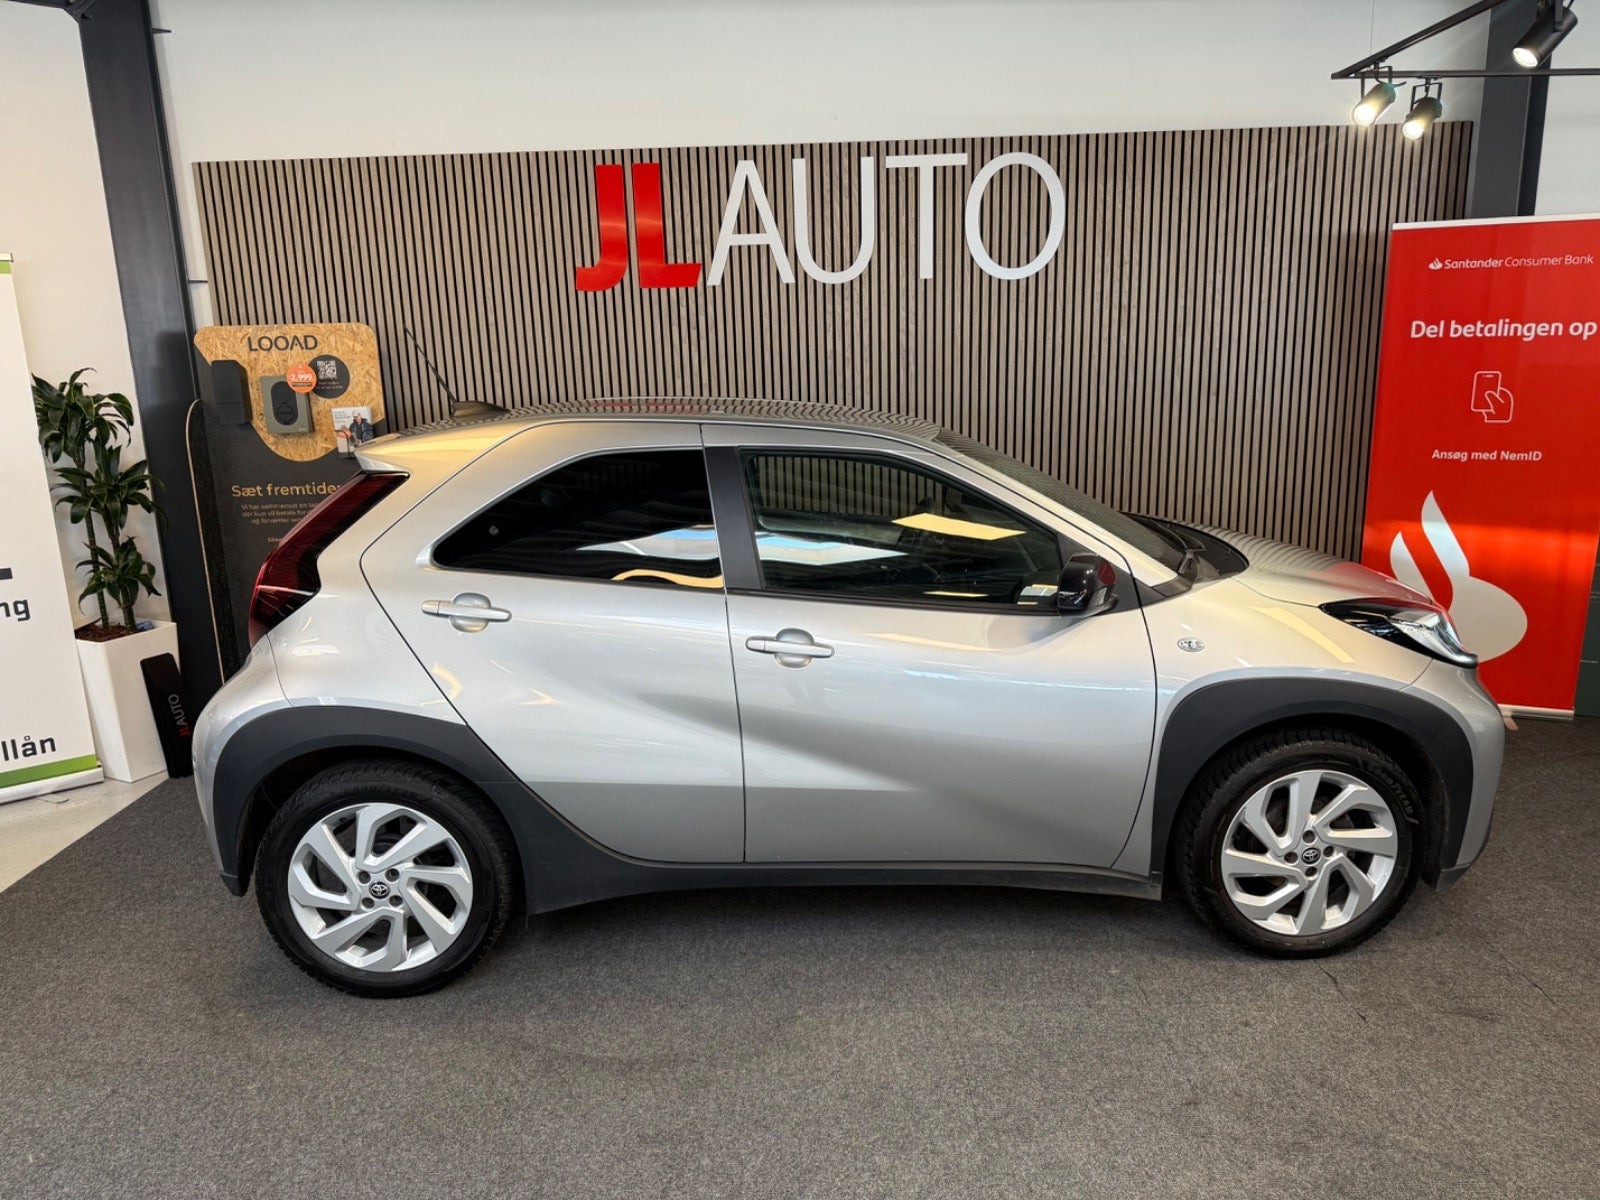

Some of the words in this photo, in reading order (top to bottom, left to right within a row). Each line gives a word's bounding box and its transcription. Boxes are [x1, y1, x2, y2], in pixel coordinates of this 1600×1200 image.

[1444, 257, 1504, 270] Santander
[1505, 256, 1562, 267] Consumer
[1565, 254, 1594, 265] Bank
[1410, 320, 1445, 338] Del
[1450, 319, 1563, 342] betalingen
[1569, 321, 1598, 341] op
[247, 335, 318, 351] LOOAD
[1432, 449, 1468, 462] Ansøg
[1471, 450, 1497, 460] med
[1500, 450, 1542, 461] NemID
[231, 485, 263, 497] Sæt
[1, 735, 57, 762] llån
